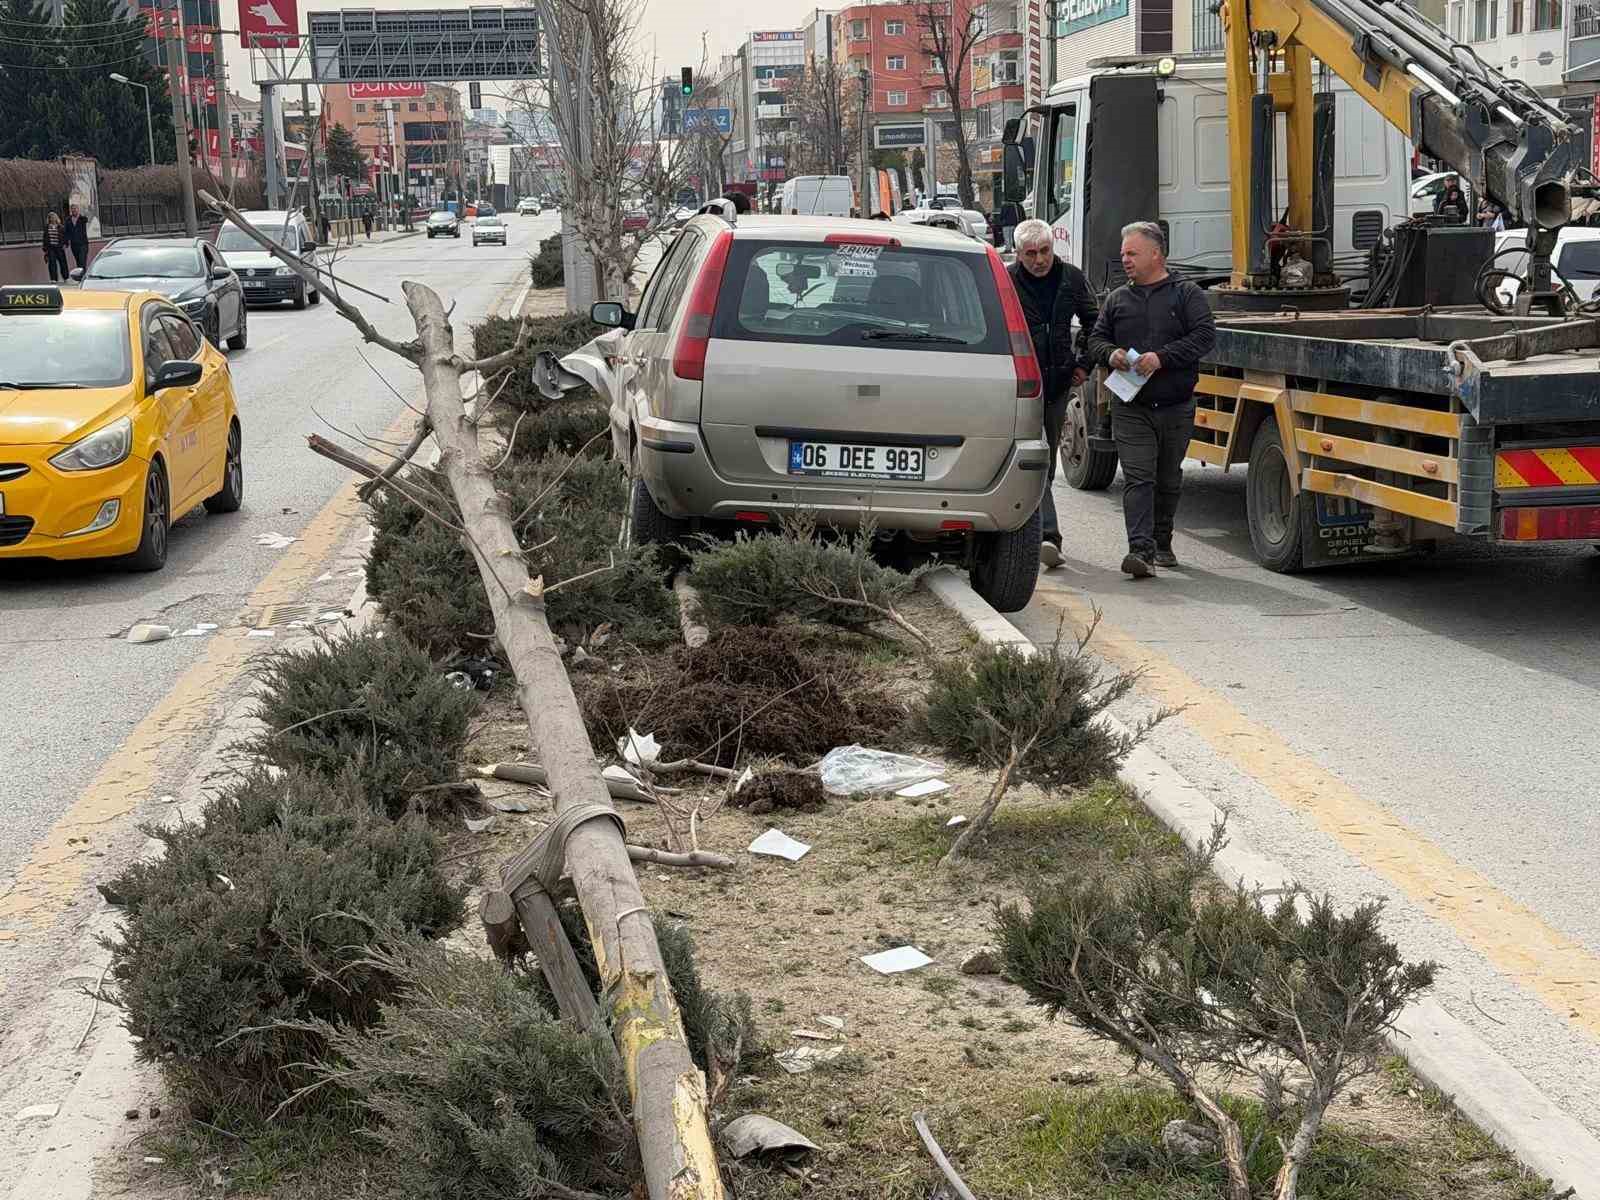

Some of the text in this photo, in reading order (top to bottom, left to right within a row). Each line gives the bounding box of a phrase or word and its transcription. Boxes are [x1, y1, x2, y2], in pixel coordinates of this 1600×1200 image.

[803, 444, 827, 468] 06
[840, 446, 876, 470] DEE
[886, 449, 921, 472] 983
[1320, 526, 1373, 538] OTOM
